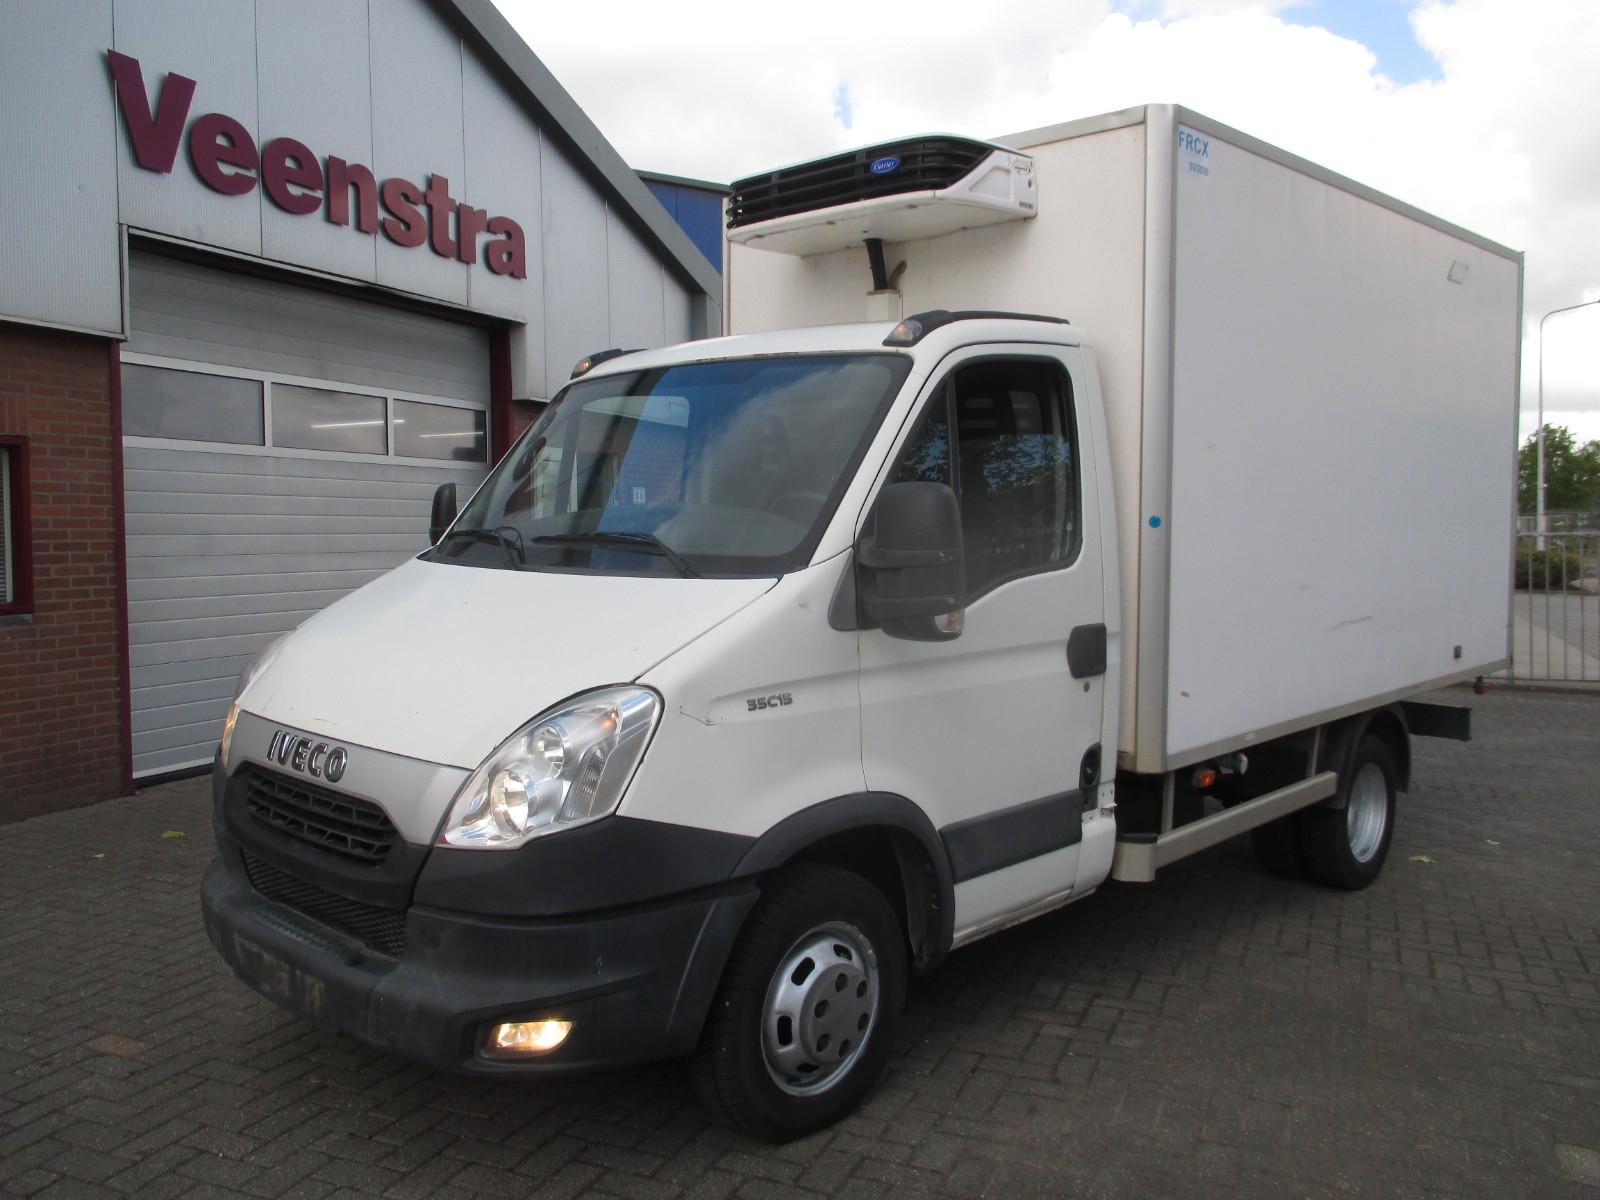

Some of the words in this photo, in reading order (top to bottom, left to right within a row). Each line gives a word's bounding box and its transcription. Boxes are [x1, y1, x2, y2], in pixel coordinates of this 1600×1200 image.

[107, 48, 528, 281] Veenstra
[1178, 130, 1209, 158] FRCX
[746, 692, 793, 711] 35C15
[266, 729, 348, 783] IVECO
